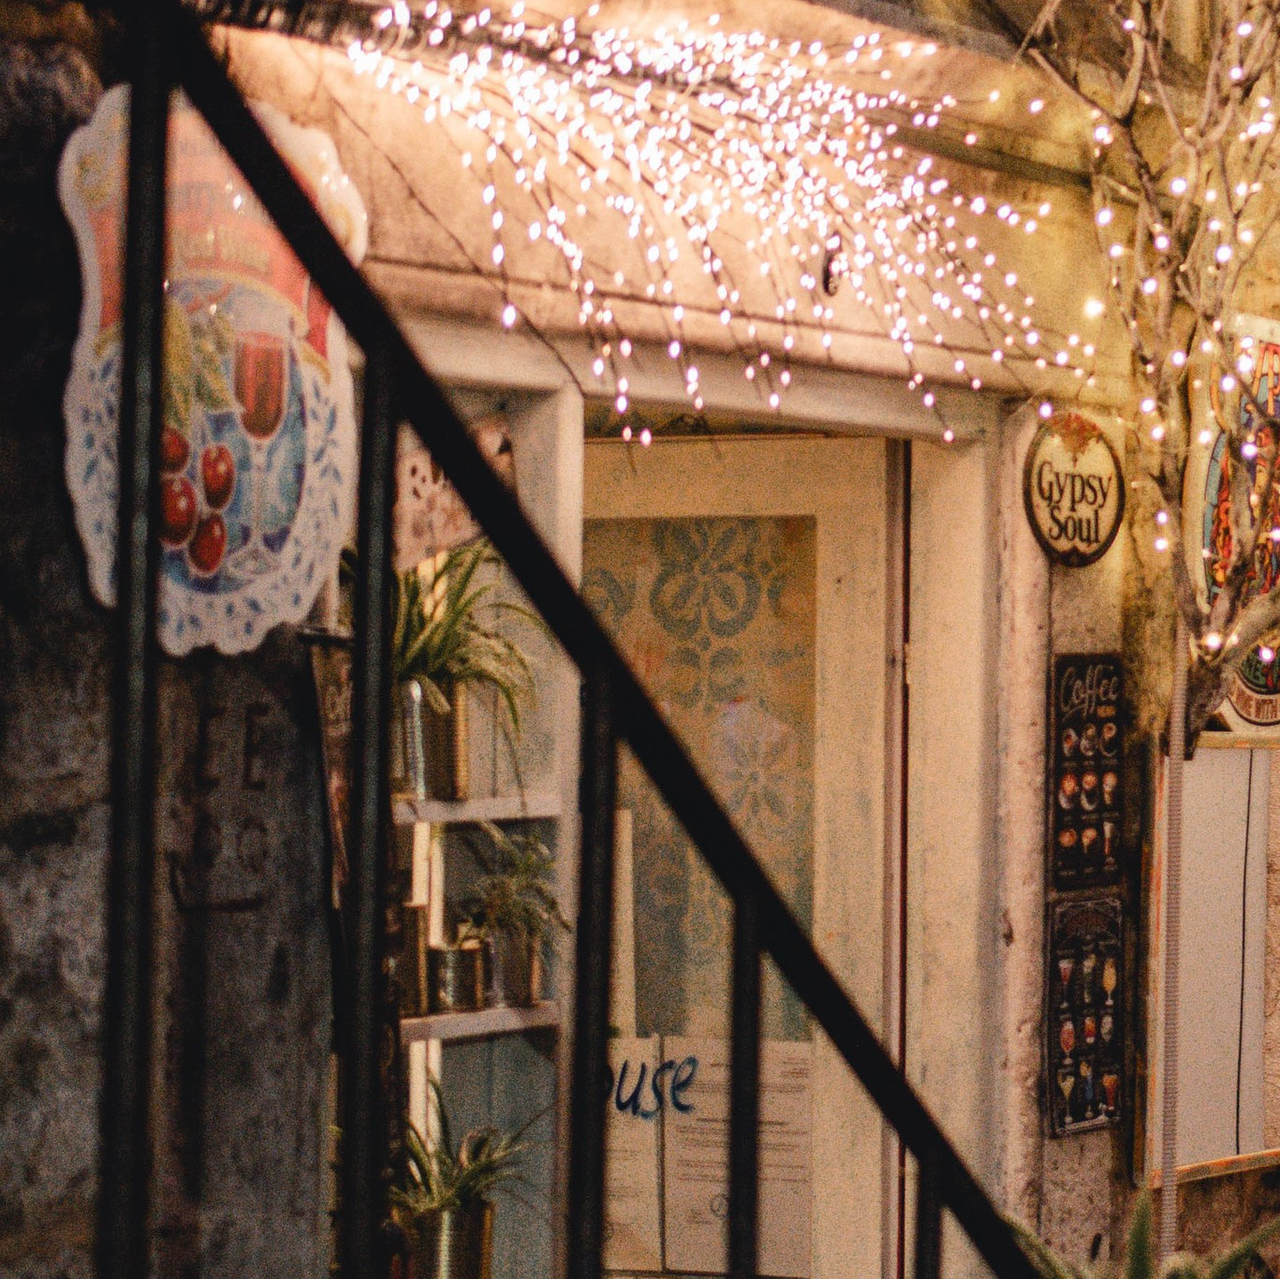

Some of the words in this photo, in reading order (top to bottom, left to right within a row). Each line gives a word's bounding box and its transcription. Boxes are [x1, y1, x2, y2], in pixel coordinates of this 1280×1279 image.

[1038, 460, 1113, 512] Gypsy
[1049, 505, 1100, 544] Soul
[605, 1054, 699, 1121] use
